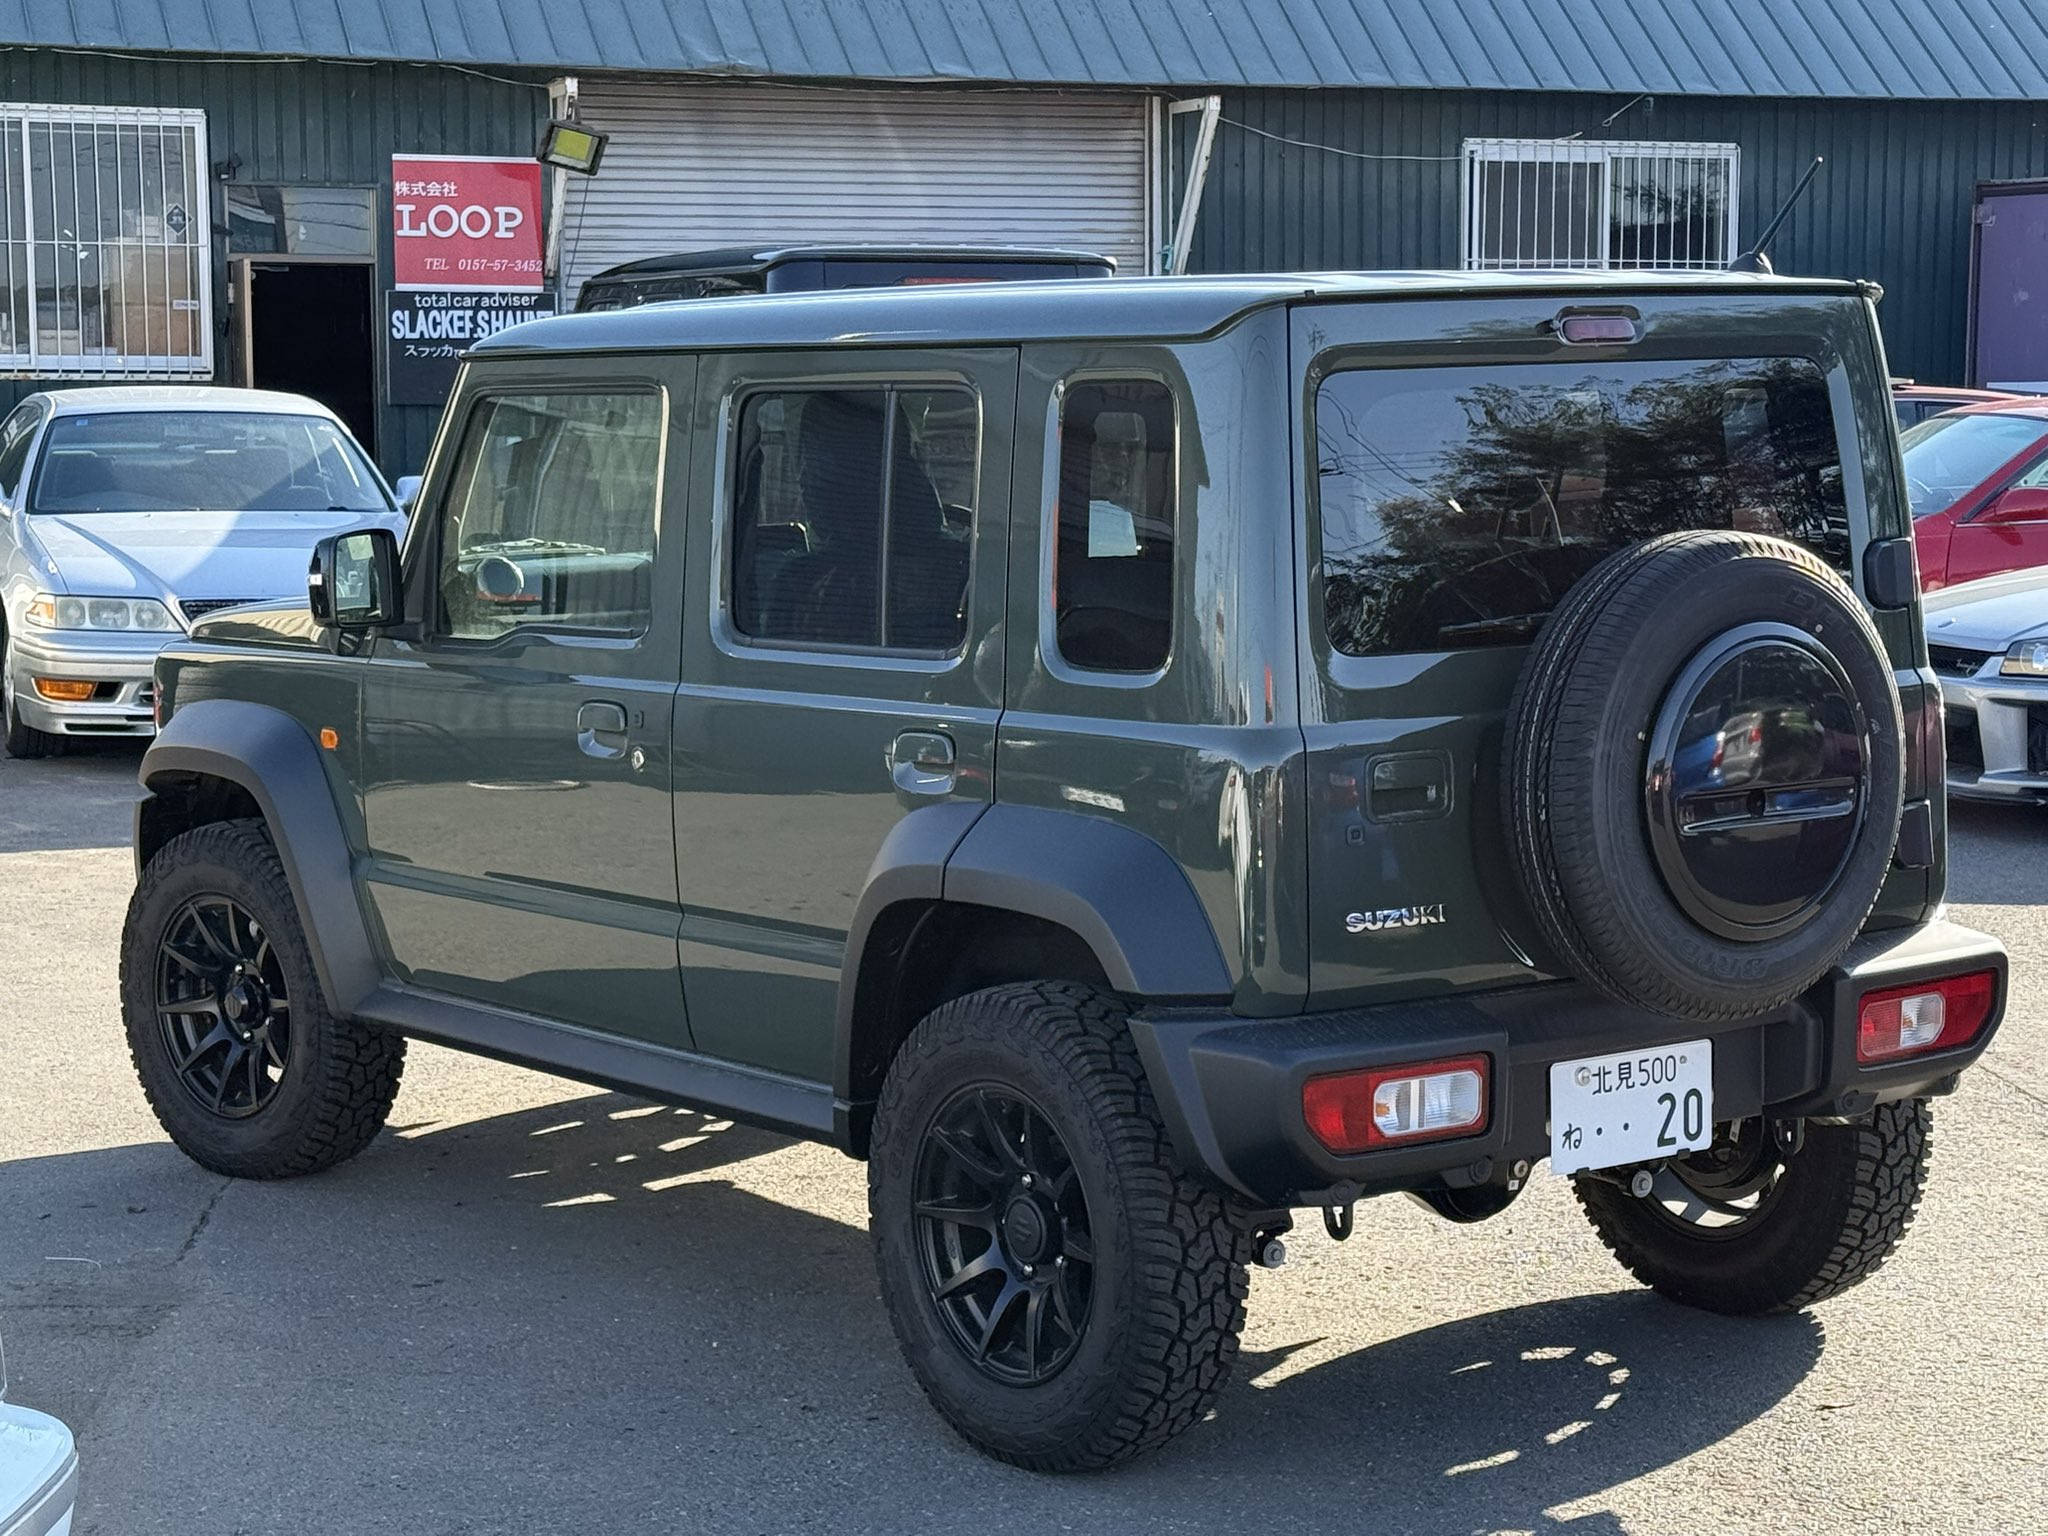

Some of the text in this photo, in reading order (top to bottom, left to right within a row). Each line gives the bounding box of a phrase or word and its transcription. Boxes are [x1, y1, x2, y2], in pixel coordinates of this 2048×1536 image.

[394, 181, 459, 198] 株式会社
[395, 203, 524, 239] LOOP
[424, 257, 543, 272] TEL 0157-57-3452
[413, 291, 539, 308] total car adviser
[1346, 903, 1447, 934] SUZUKI
[1561, 1122, 1583, 1151] ね
[1656, 1087, 1704, 1148] 20
